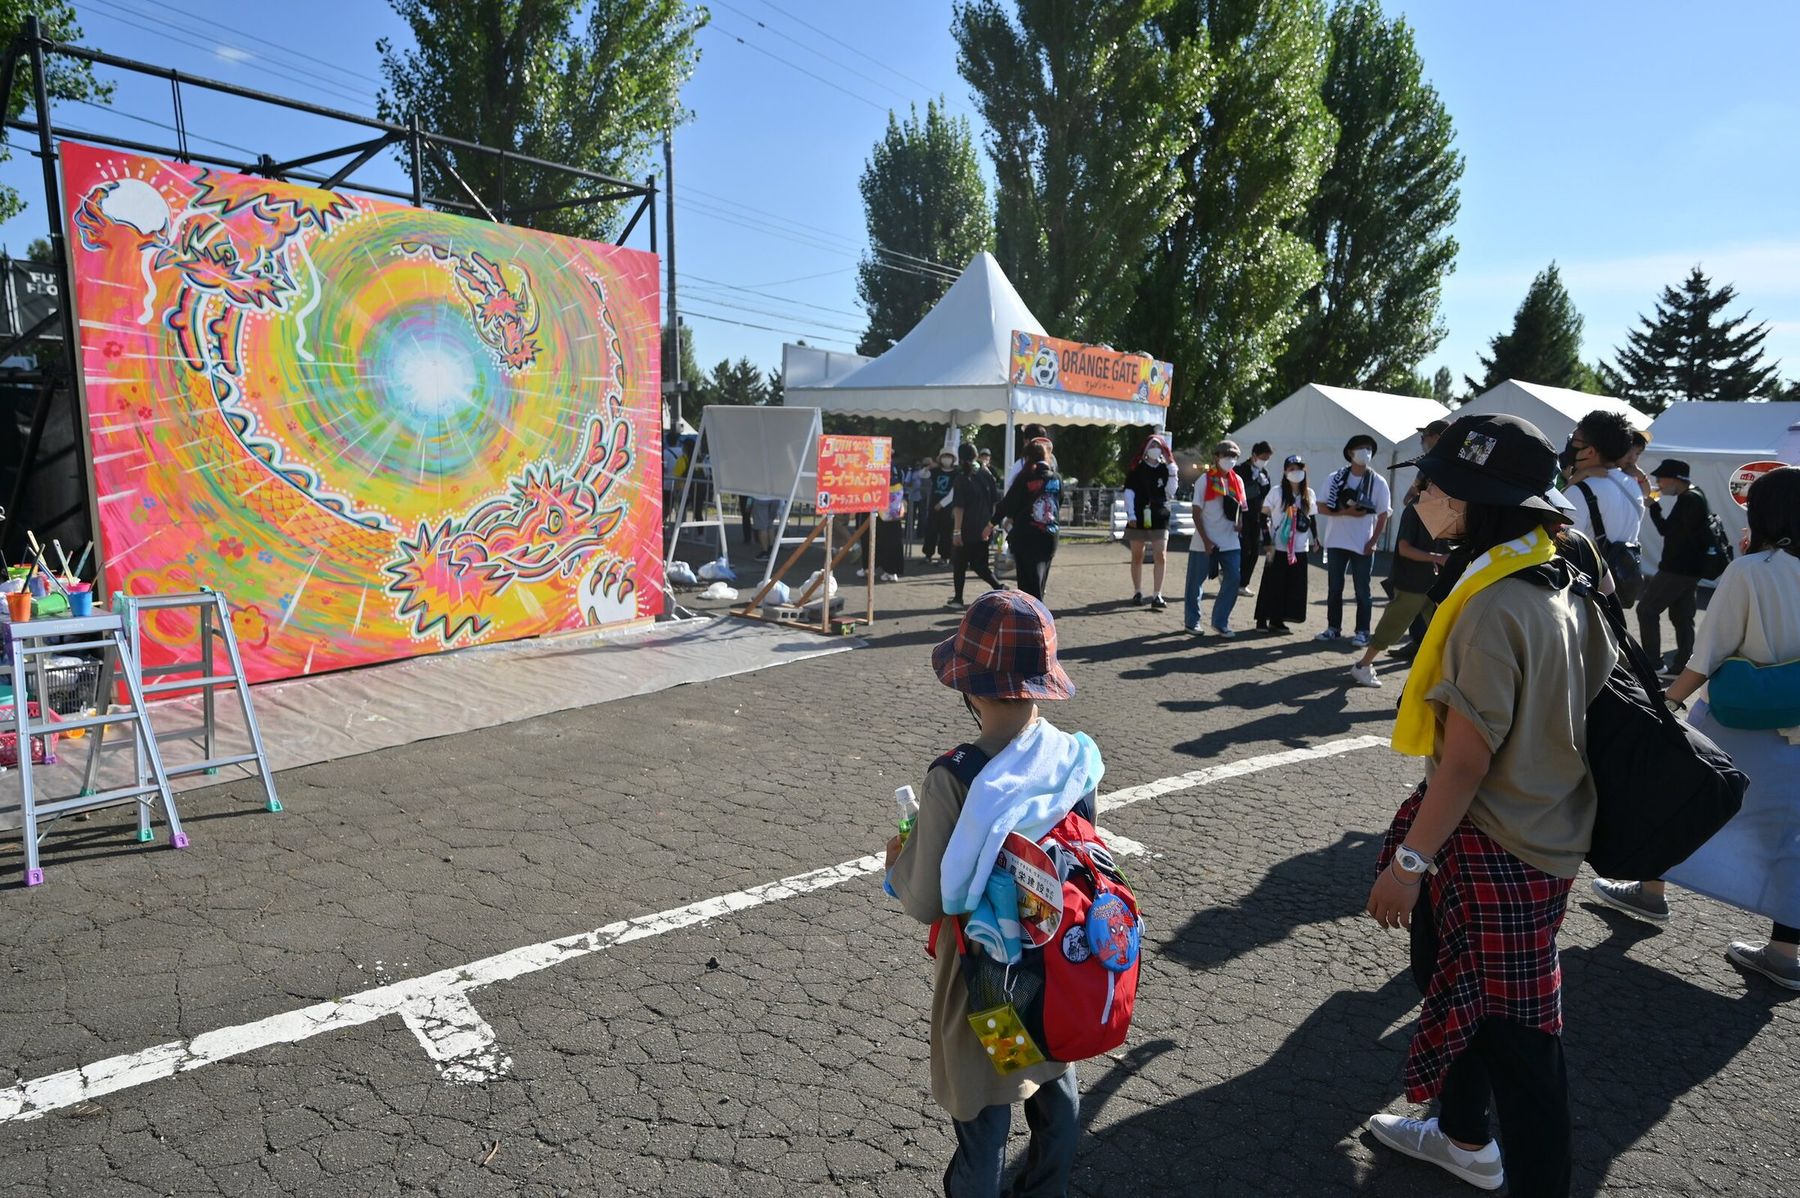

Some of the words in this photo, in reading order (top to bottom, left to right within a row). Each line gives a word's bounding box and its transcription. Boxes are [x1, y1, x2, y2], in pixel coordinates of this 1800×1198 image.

[29, 271, 57, 284] FU
[1061, 349, 1109, 380] ORANGE
[1112, 358, 1139, 385] GATE
